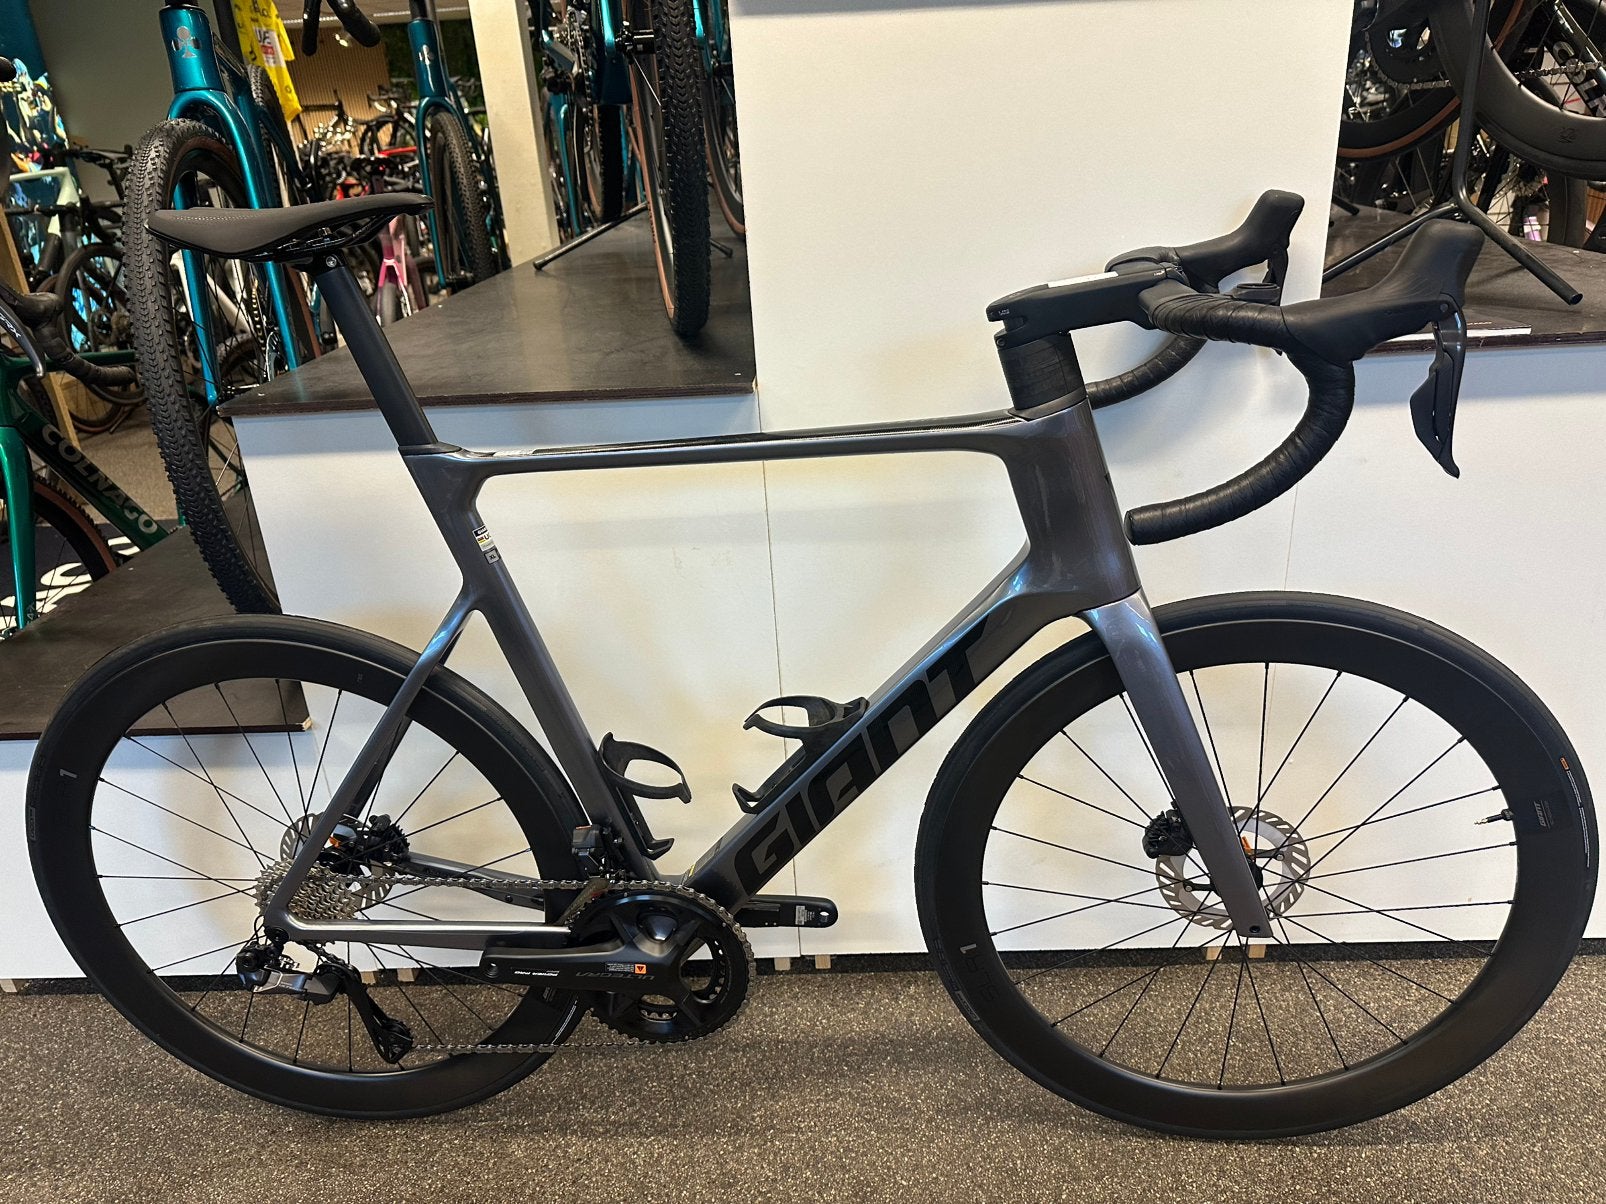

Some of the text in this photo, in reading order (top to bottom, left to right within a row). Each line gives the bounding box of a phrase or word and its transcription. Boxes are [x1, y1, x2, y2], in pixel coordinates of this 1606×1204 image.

[41, 423, 158, 535] COLNAGO
[733, 613, 990, 896] GIANT
[575, 971, 655, 981] ULTEGRA
